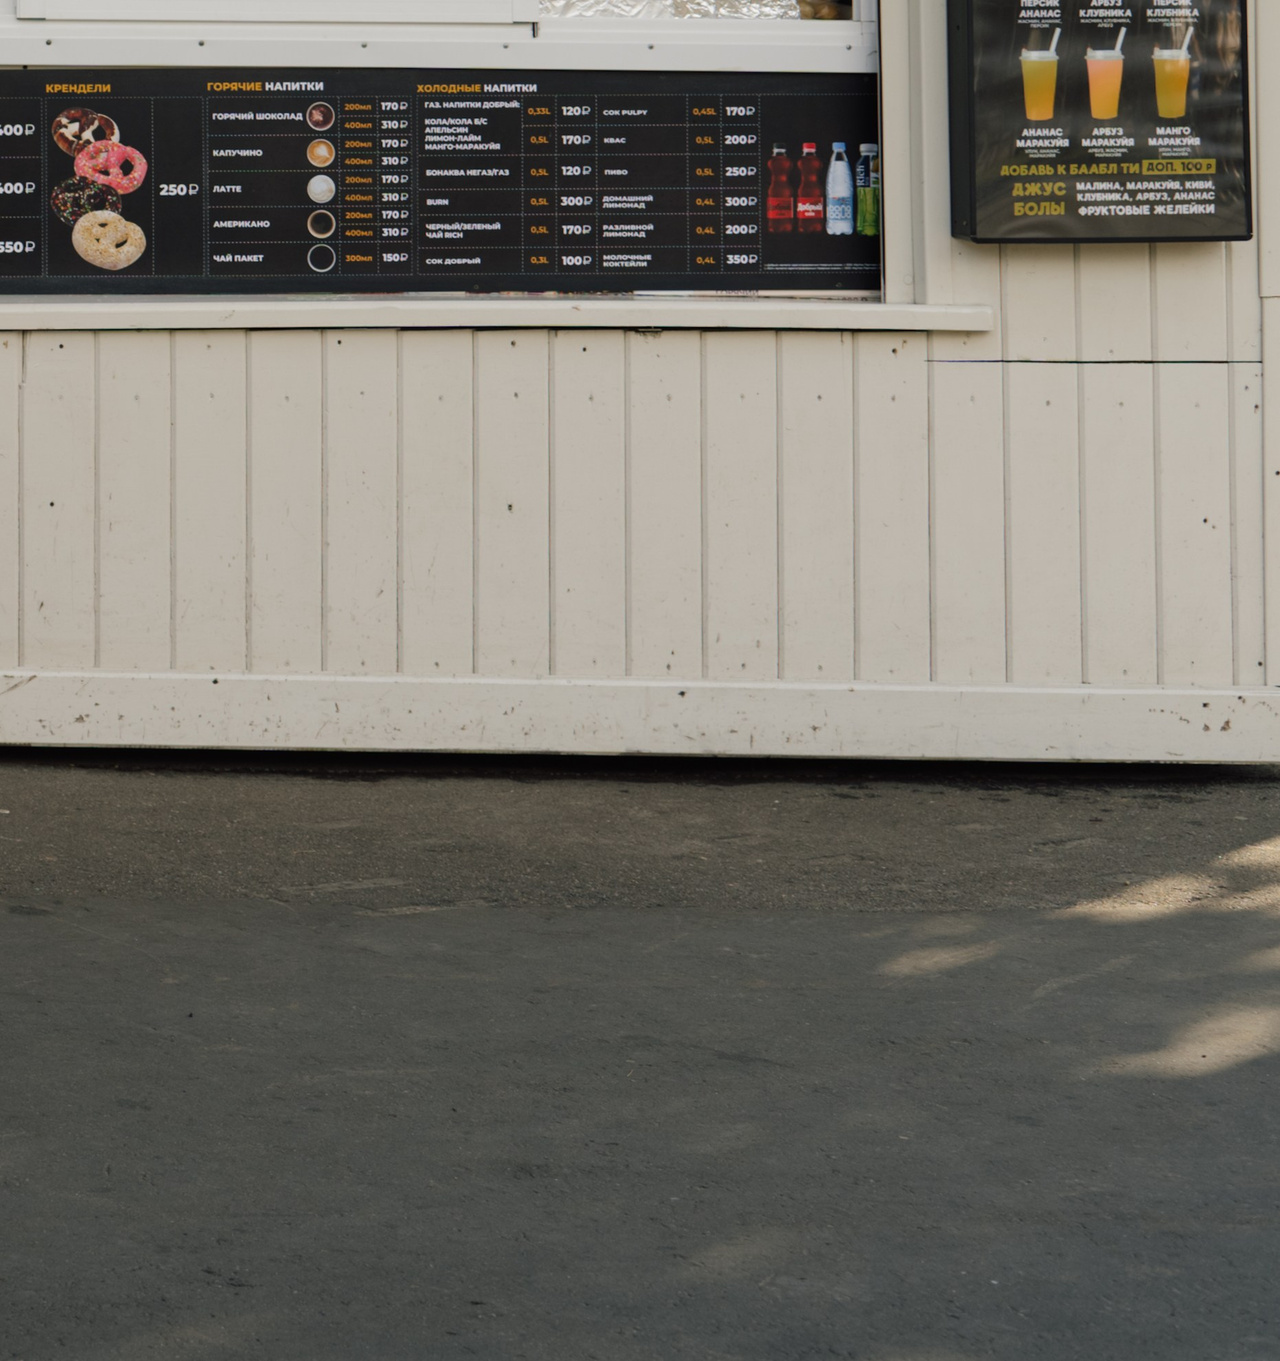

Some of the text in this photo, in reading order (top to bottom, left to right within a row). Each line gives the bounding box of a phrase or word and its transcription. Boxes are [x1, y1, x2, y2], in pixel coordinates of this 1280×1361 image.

[1019, 9, 1061, 18] АНАНАС
[1079, 9, 1132, 17] КЛУБНИКА
[1146, 8, 1199, 17] КЛУБНИКА
[45, 84, 111, 94] КРЕНДЕЛИ
[207, 81, 324, 91] ГОРЯЧИЕ НАПИТКИ
[417, 84, 537, 93] ХОЛОДНЫЕ НАПИТКИ
[482, 100, 520, 109] ДОБРЫЙ:
[212, 111, 303, 121] ГОРЯЧИЙ ШОКОЛАД
[424, 126, 468, 134] АПЕЛЬСИН
[1021, 128, 1063, 137] АНАНАС
[1092, 127, 1123, 136] АРБУЗ
[1156, 126, 1191, 135] МАНГО
[424, 134, 481, 142] ЛИМОН-ЛАЙМ
[1016, 137, 1069, 147] МАРАКУЙЯ
[1081, 136, 1134, 147] МАРАКУЙЯ
[1148, 135, 1200, 146] МАРАКУЙЯ
[424, 142, 501, 151] МАНГО-МАРАКУЙЯ
[213, 149, 263, 158] КАПУЧИНО
[466, 169, 509, 177] НЕГАЗ/ГАЗ
[1000, 165, 1054, 176] ДОБАВЬ
[1057, 165, 1066, 175] К
[1070, 164, 1118, 175] БААБЛ
[1120, 163, 1140, 174] ТИ
[1146, 162, 1177, 172] ДОП.
[213, 185, 242, 193] ЛАТТЕ
[1012, 182, 1066, 196] ДЖУС
[1076, 180, 1215, 191] МАЛИНА, МАРАКУЙЯ, КИВИ,
[602, 195, 654, 203] ДОМАШНИЙ
[1076, 191, 1215, 202] КЛУБНИКА, АРБУЗ, АНАНАС
[426, 198, 449, 206] BURN
[1014, 202, 1065, 216] БОЛЫ
[1078, 202, 1215, 216] ФРУКТОВЫЕ ЖЕЛЕЙКИ
[213, 220, 270, 228] АМЕРИКАНО
[426, 222, 501, 231] ЧЕРНЫЙ/ЗЕЛЕНЫЙ
[602, 223, 654, 231] РАЗЛИВНОЙ
[426, 230, 463, 239] ЧАЙ RICH
[213, 254, 264, 262] ЧАЙ ПАКЕТ
[444, 257, 481, 265] ДОБРЫЙ
[603, 260, 648, 268] КОКТЕЙЛИ
